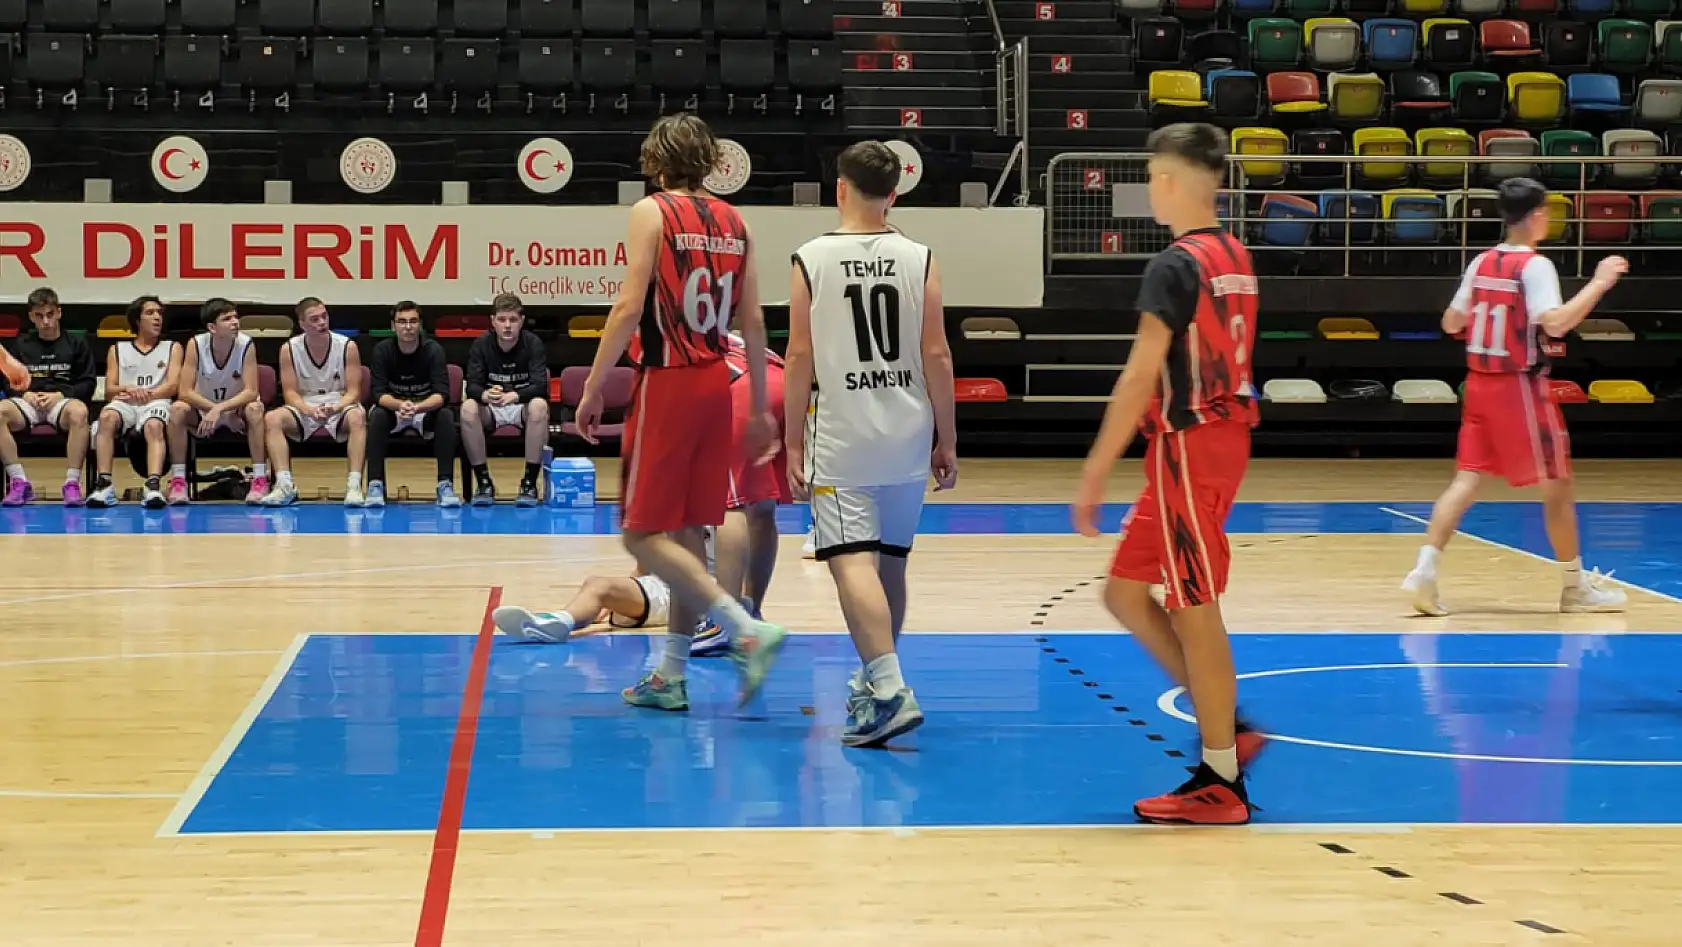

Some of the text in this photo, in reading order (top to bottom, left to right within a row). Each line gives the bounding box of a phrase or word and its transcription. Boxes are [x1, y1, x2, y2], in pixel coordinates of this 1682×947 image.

[1039, 6, 1052, 20] 5
[897, 55, 909, 71] 3
[1055, 57, 1068, 73] 4
[905, 111, 918, 128] 2
[1072, 113, 1084, 128] 3
[1087, 172, 1101, 188] 2
[1108, 235, 1118, 253] 1
[488, 242, 628, 266] Dr. Osman A
[840, 256, 896, 278] TEMİZ
[518, 275, 573, 299] Gençlik
[577, 281, 594, 294] ve
[683, 267, 733, 336] 61
[843, 283, 900, 362] 10
[1467, 301, 1511, 356] 11
[213, 387, 228, 400] 17
